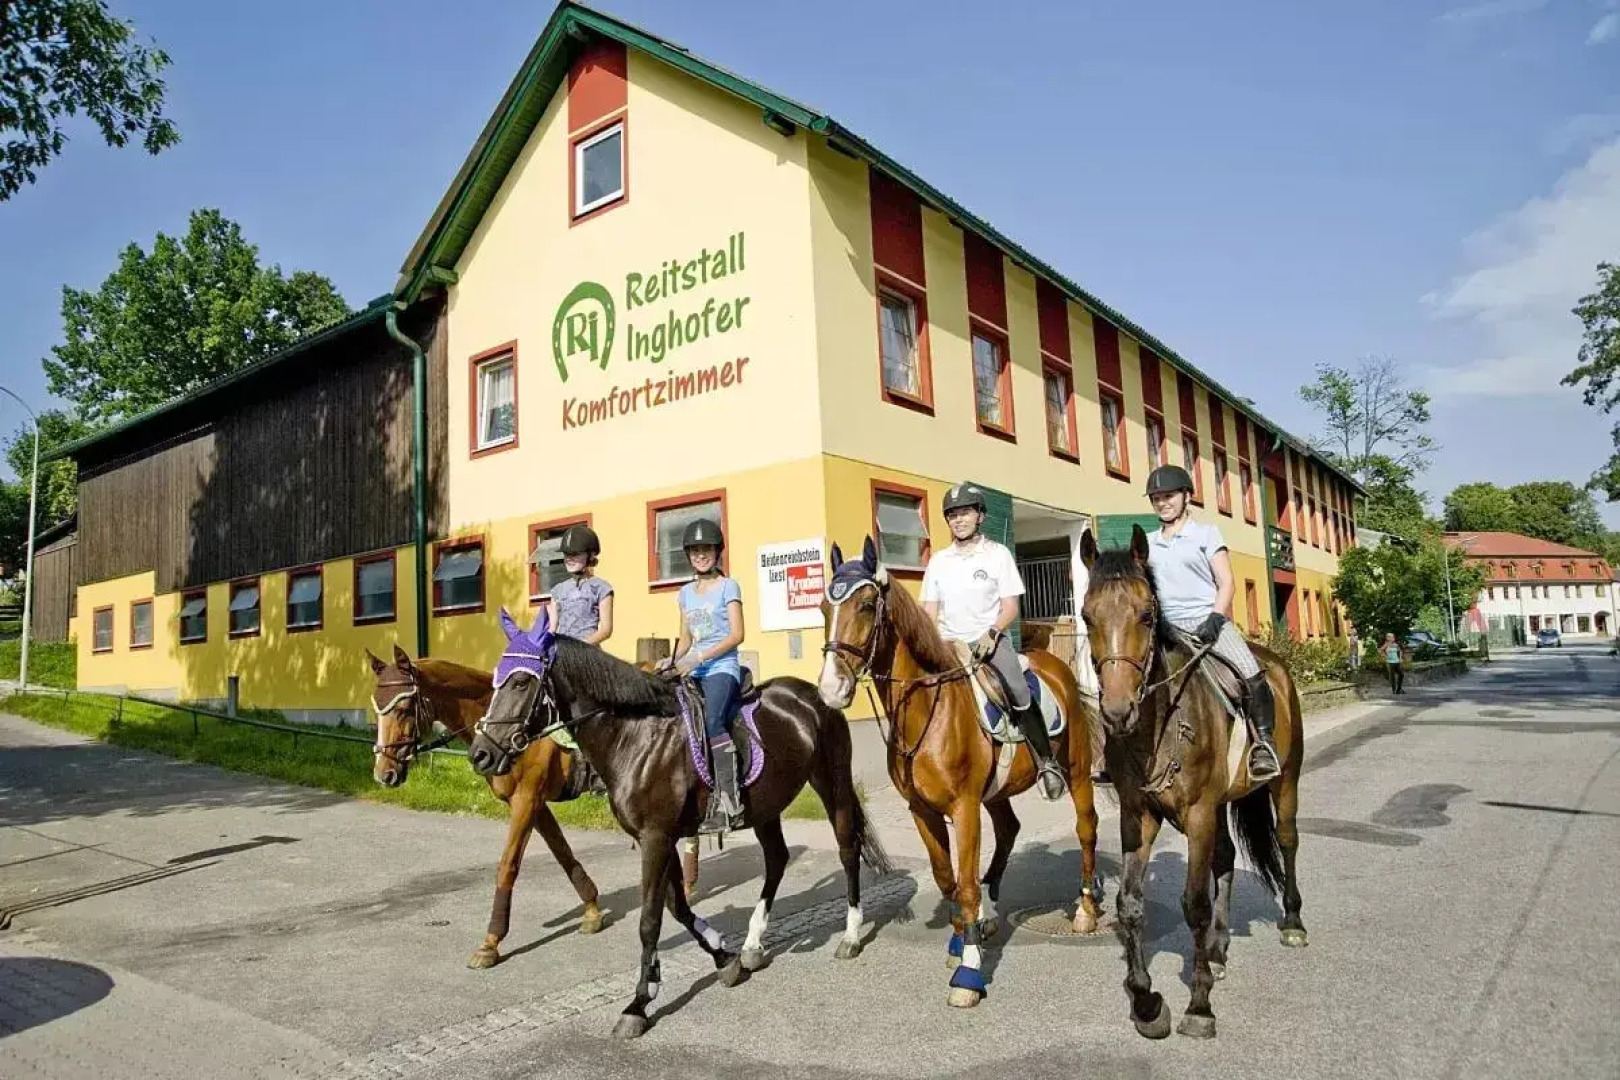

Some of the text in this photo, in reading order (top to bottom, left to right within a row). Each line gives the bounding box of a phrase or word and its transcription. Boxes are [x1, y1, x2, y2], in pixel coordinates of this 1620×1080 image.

[626, 231, 745, 310] Reitstall
[627, 296, 750, 363] Inghofer
[562, 356, 750, 430] Komfortzimmer
